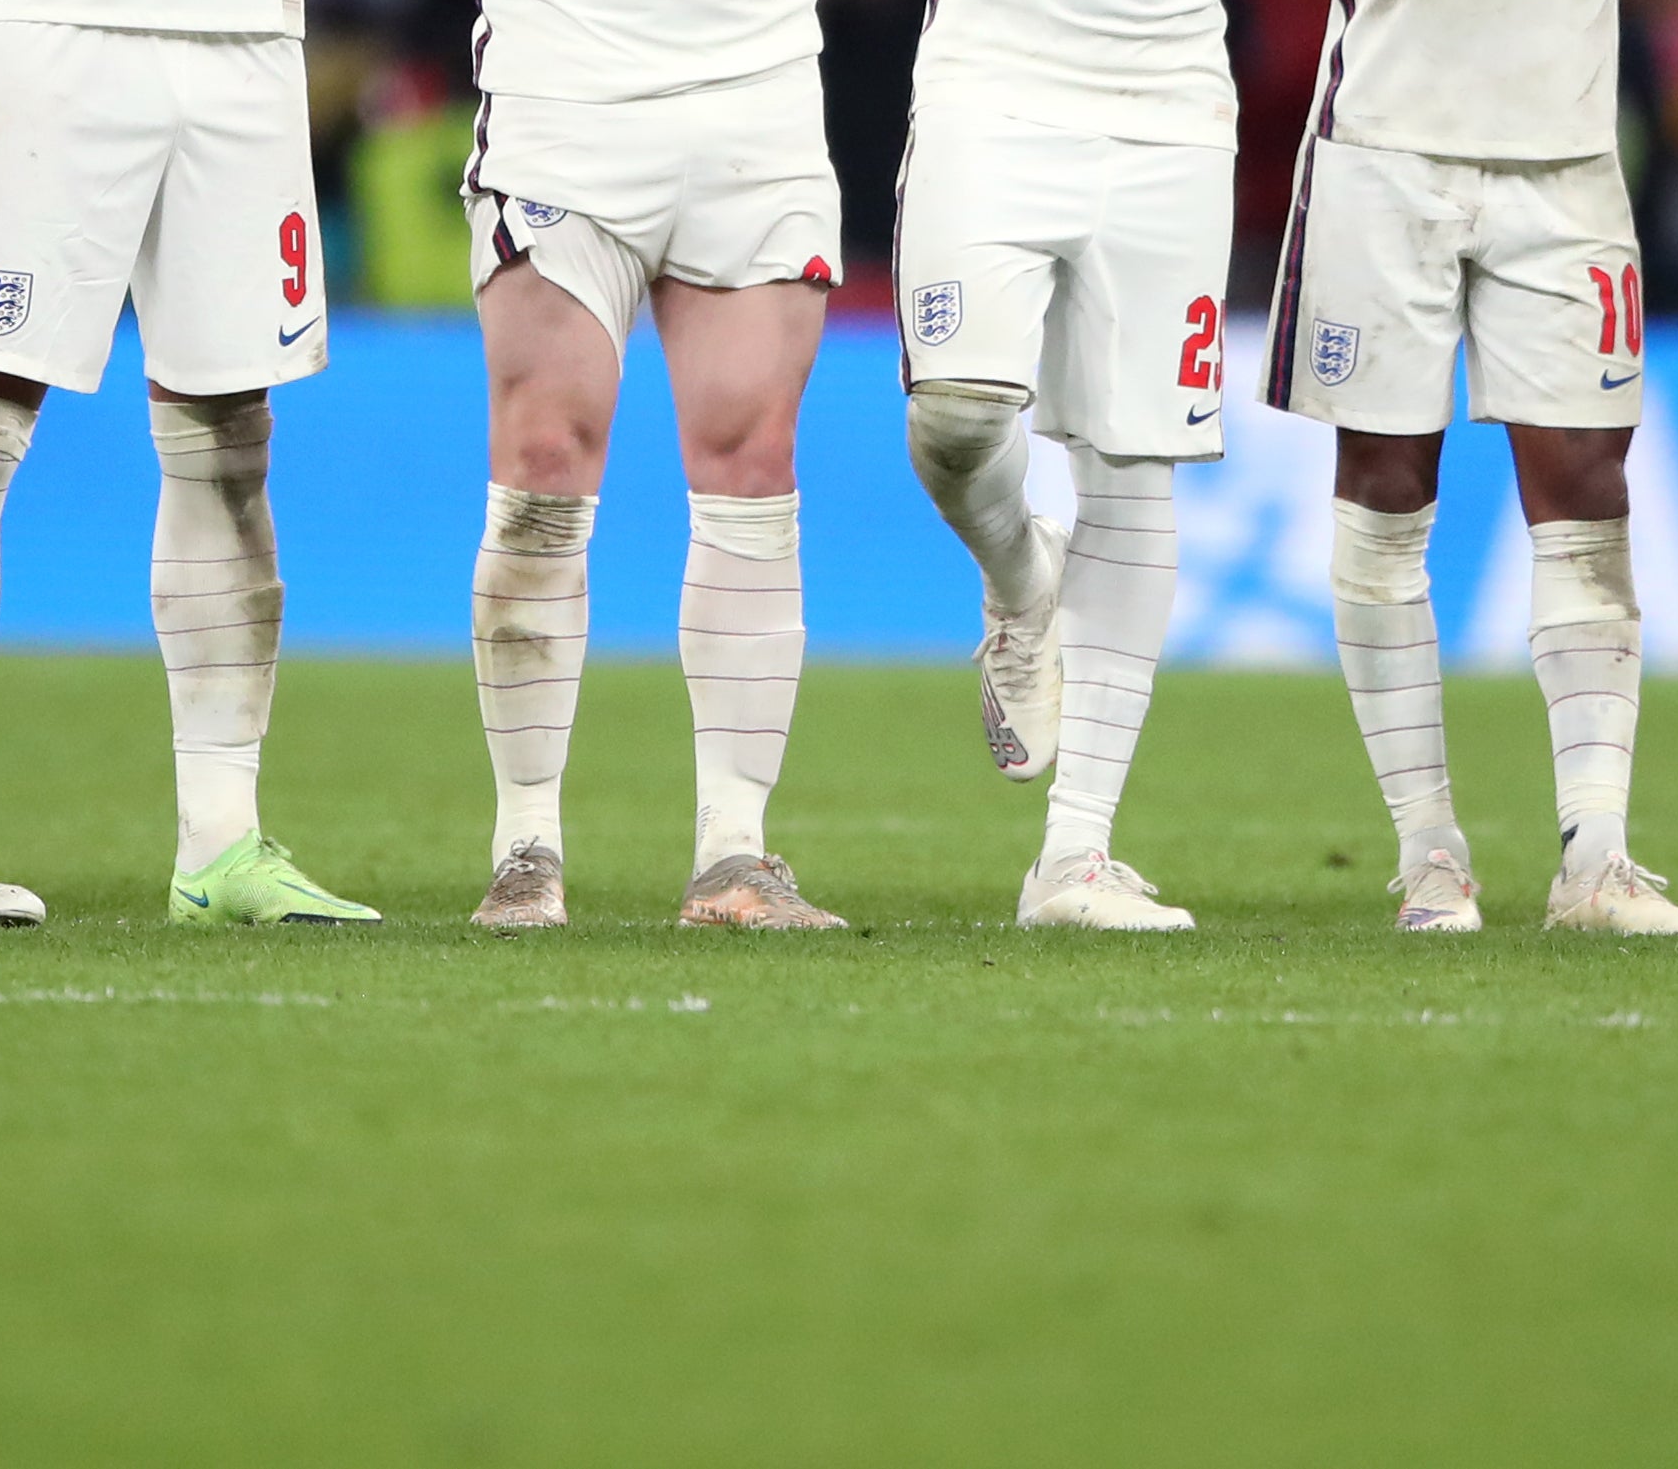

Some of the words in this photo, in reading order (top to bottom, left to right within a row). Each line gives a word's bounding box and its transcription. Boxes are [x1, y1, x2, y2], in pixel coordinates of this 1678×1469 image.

[278, 210, 309, 308] 9
[1177, 294, 1228, 390] 2
[1587, 262, 1644, 357] 10
